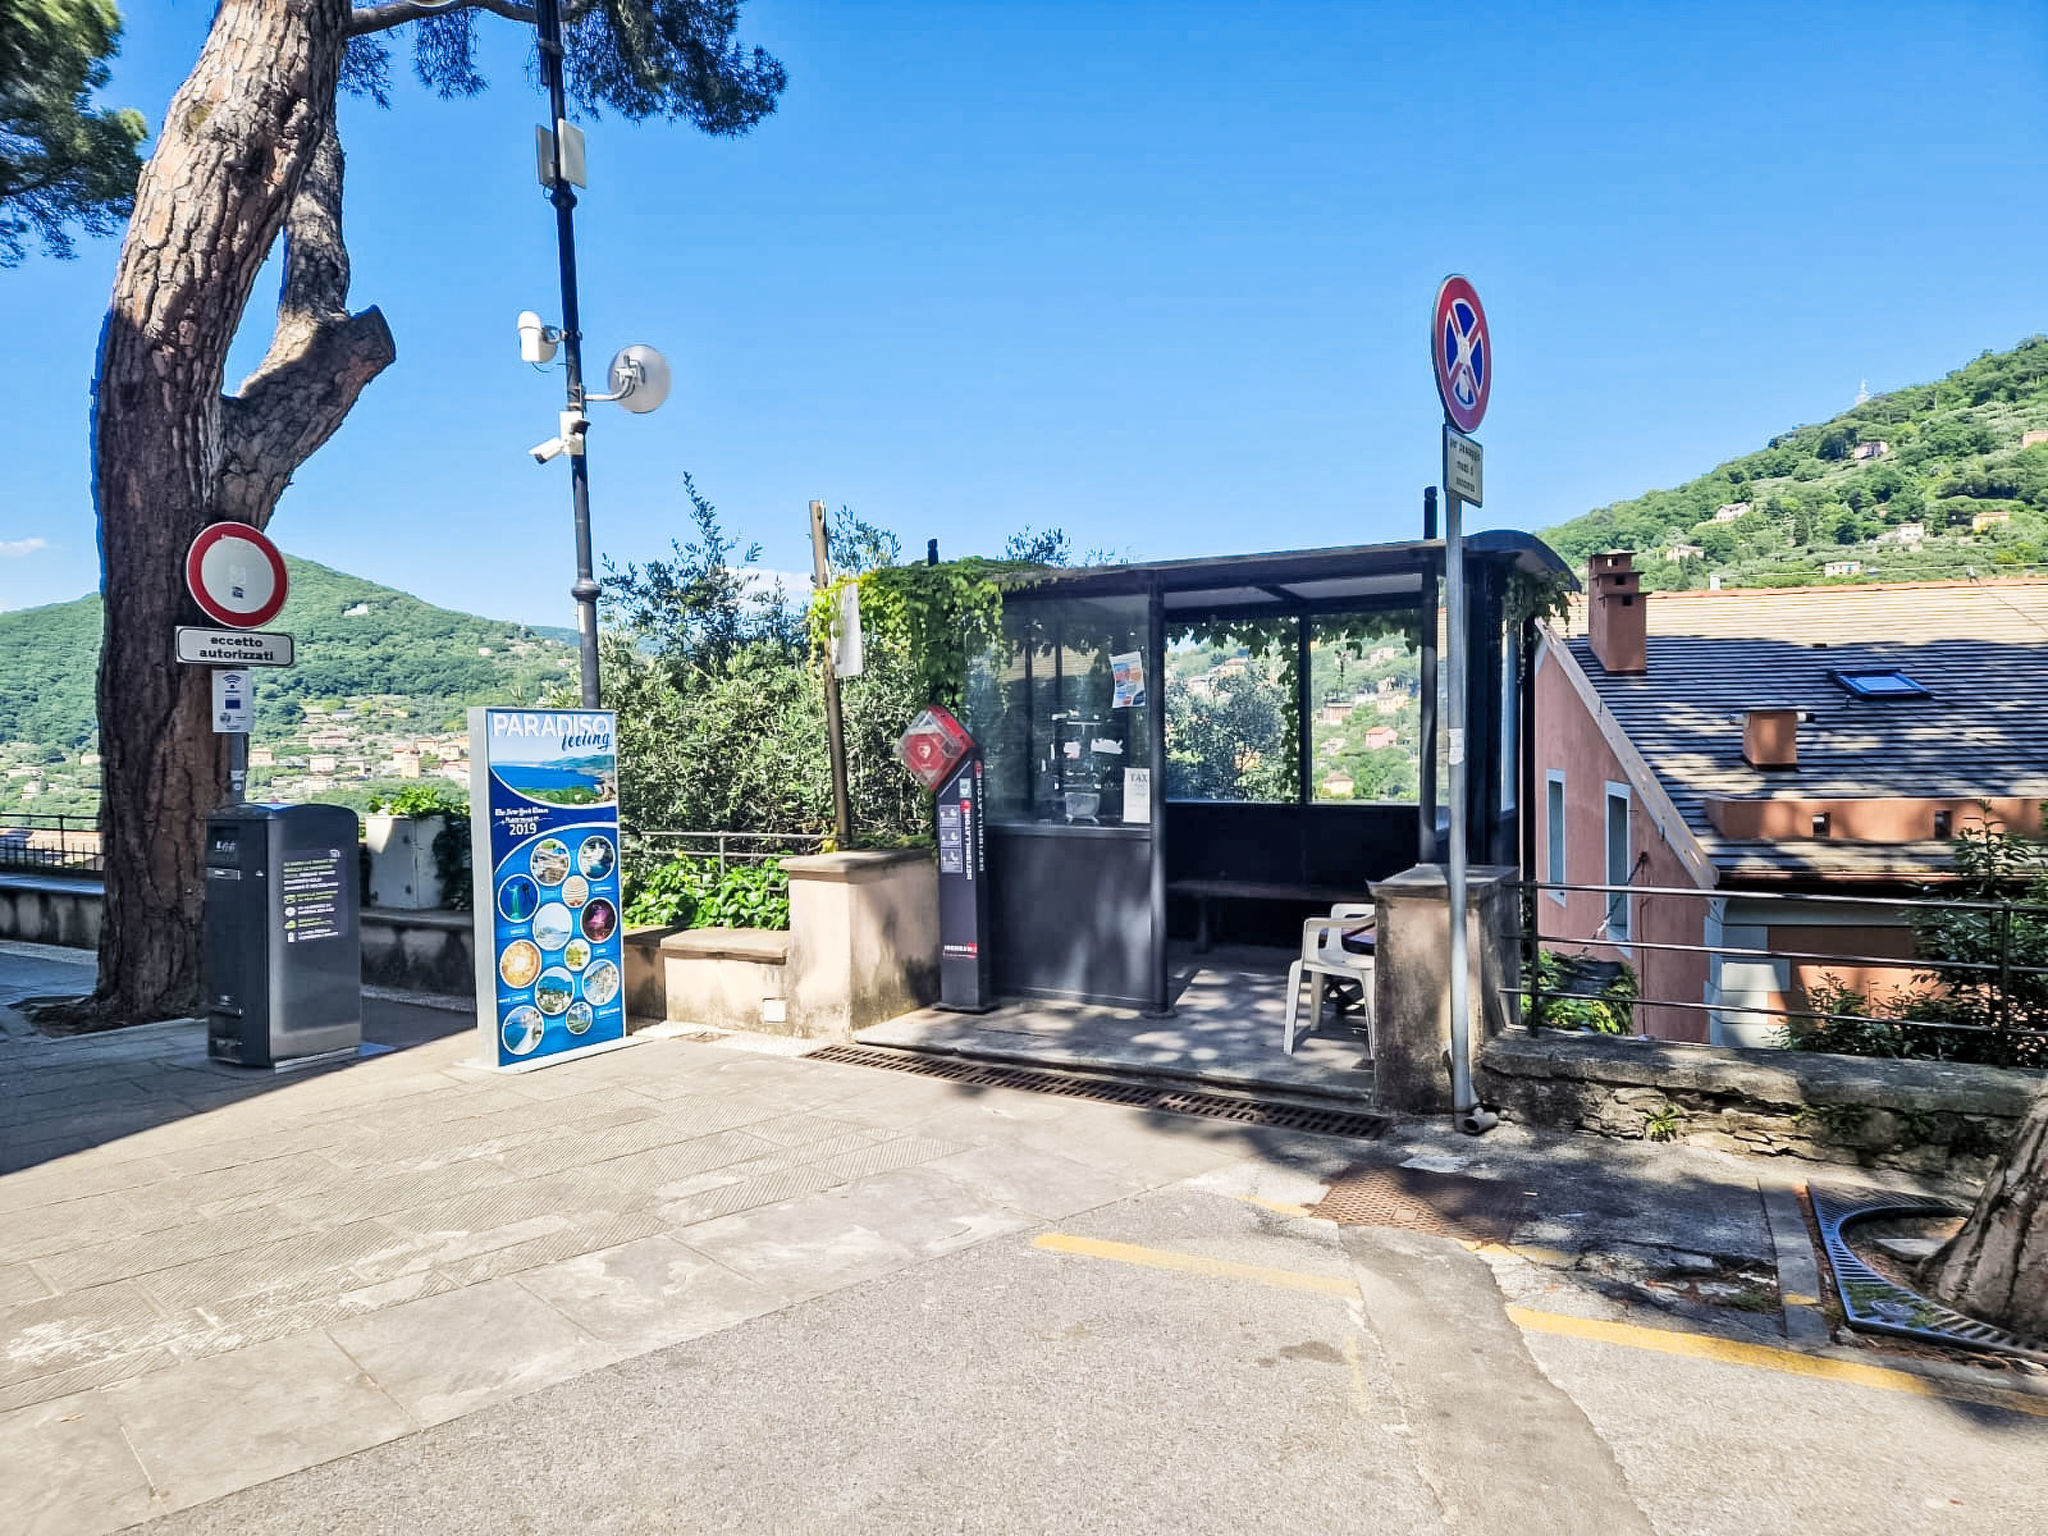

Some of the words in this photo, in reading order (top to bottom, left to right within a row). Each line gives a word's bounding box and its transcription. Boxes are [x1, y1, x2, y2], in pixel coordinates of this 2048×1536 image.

[210, 636, 264, 648] eccetto
[199, 648, 274, 662] autorizzati
[492, 714, 609, 738] PARADISO
[561, 730, 612, 751] feeling
[509, 822, 537, 836] 2019
